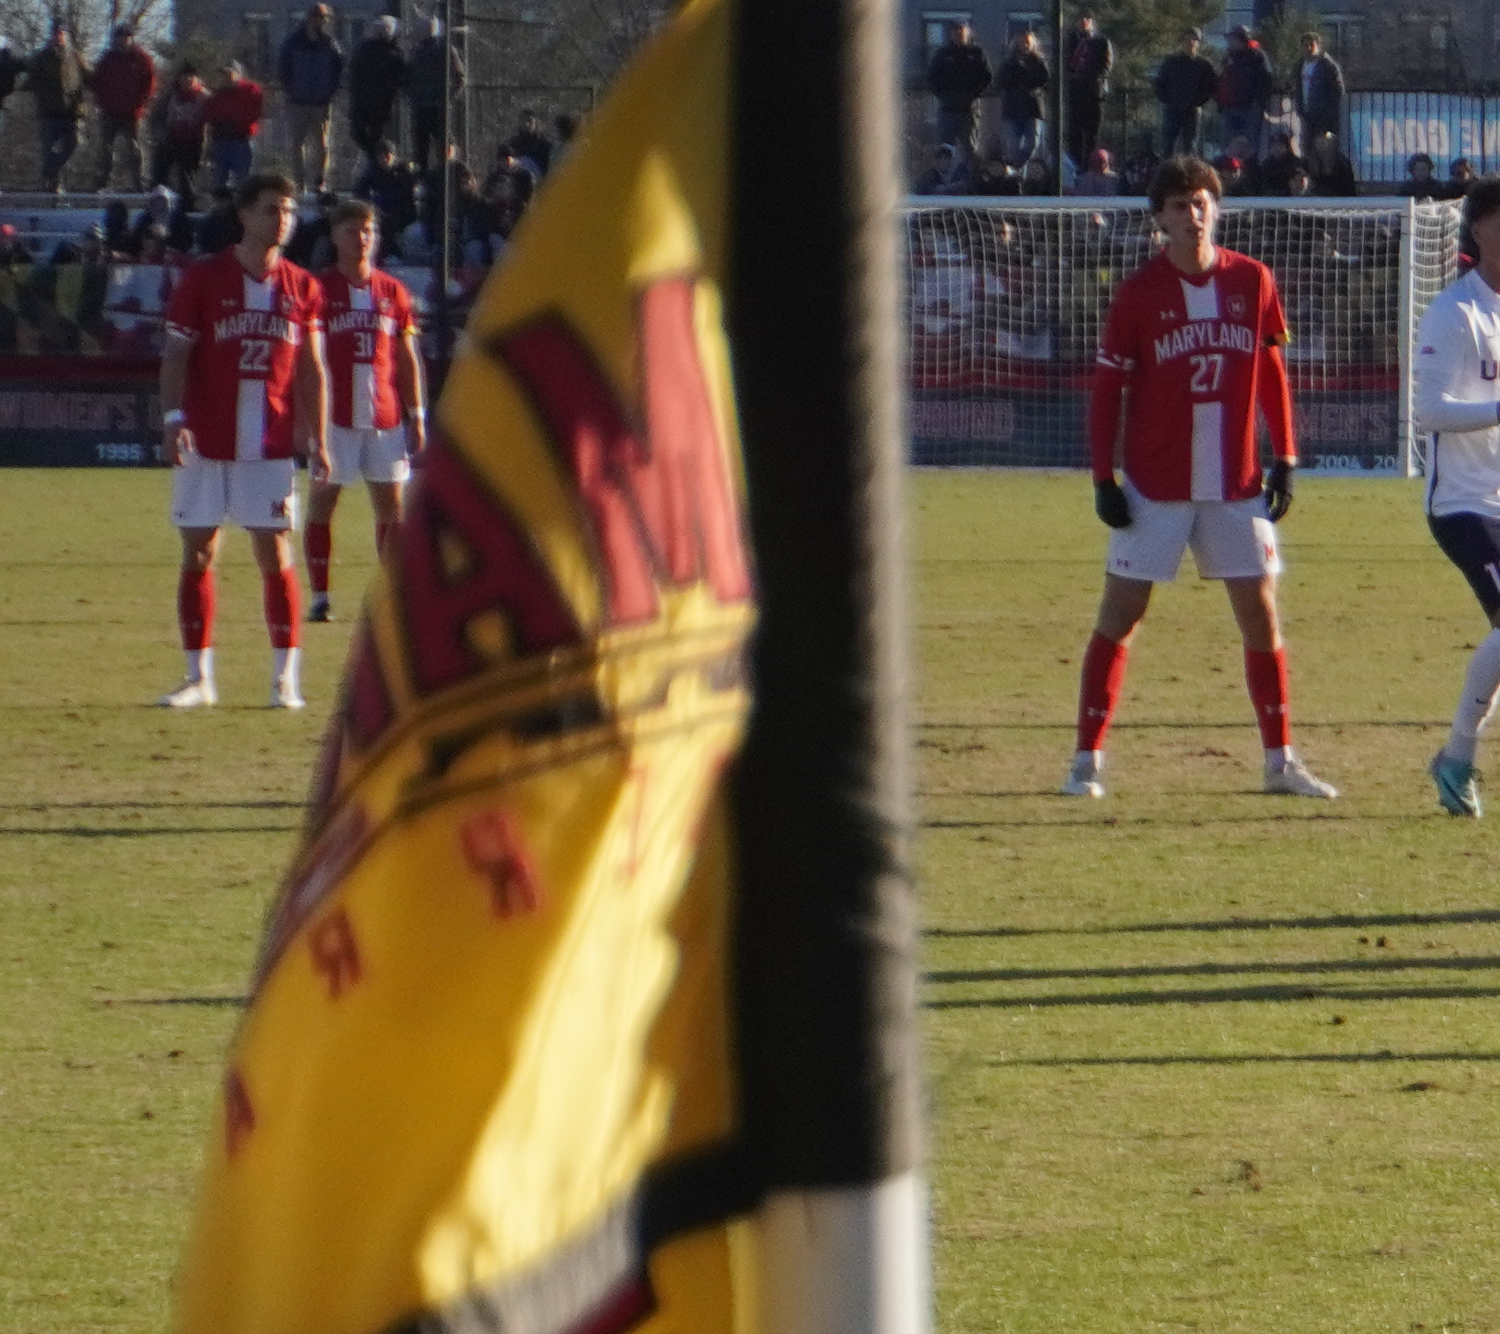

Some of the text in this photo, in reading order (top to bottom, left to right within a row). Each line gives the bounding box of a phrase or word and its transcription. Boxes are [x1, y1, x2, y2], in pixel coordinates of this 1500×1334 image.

[327, 310, 397, 336] MARYLA
[239, 338, 270, 371] 22
[354, 331, 374, 357] 31
[1153, 322, 1255, 365] MARYLAND
[1189, 353, 1224, 392] 27
[1298, 403, 1389, 441] MEN'S
